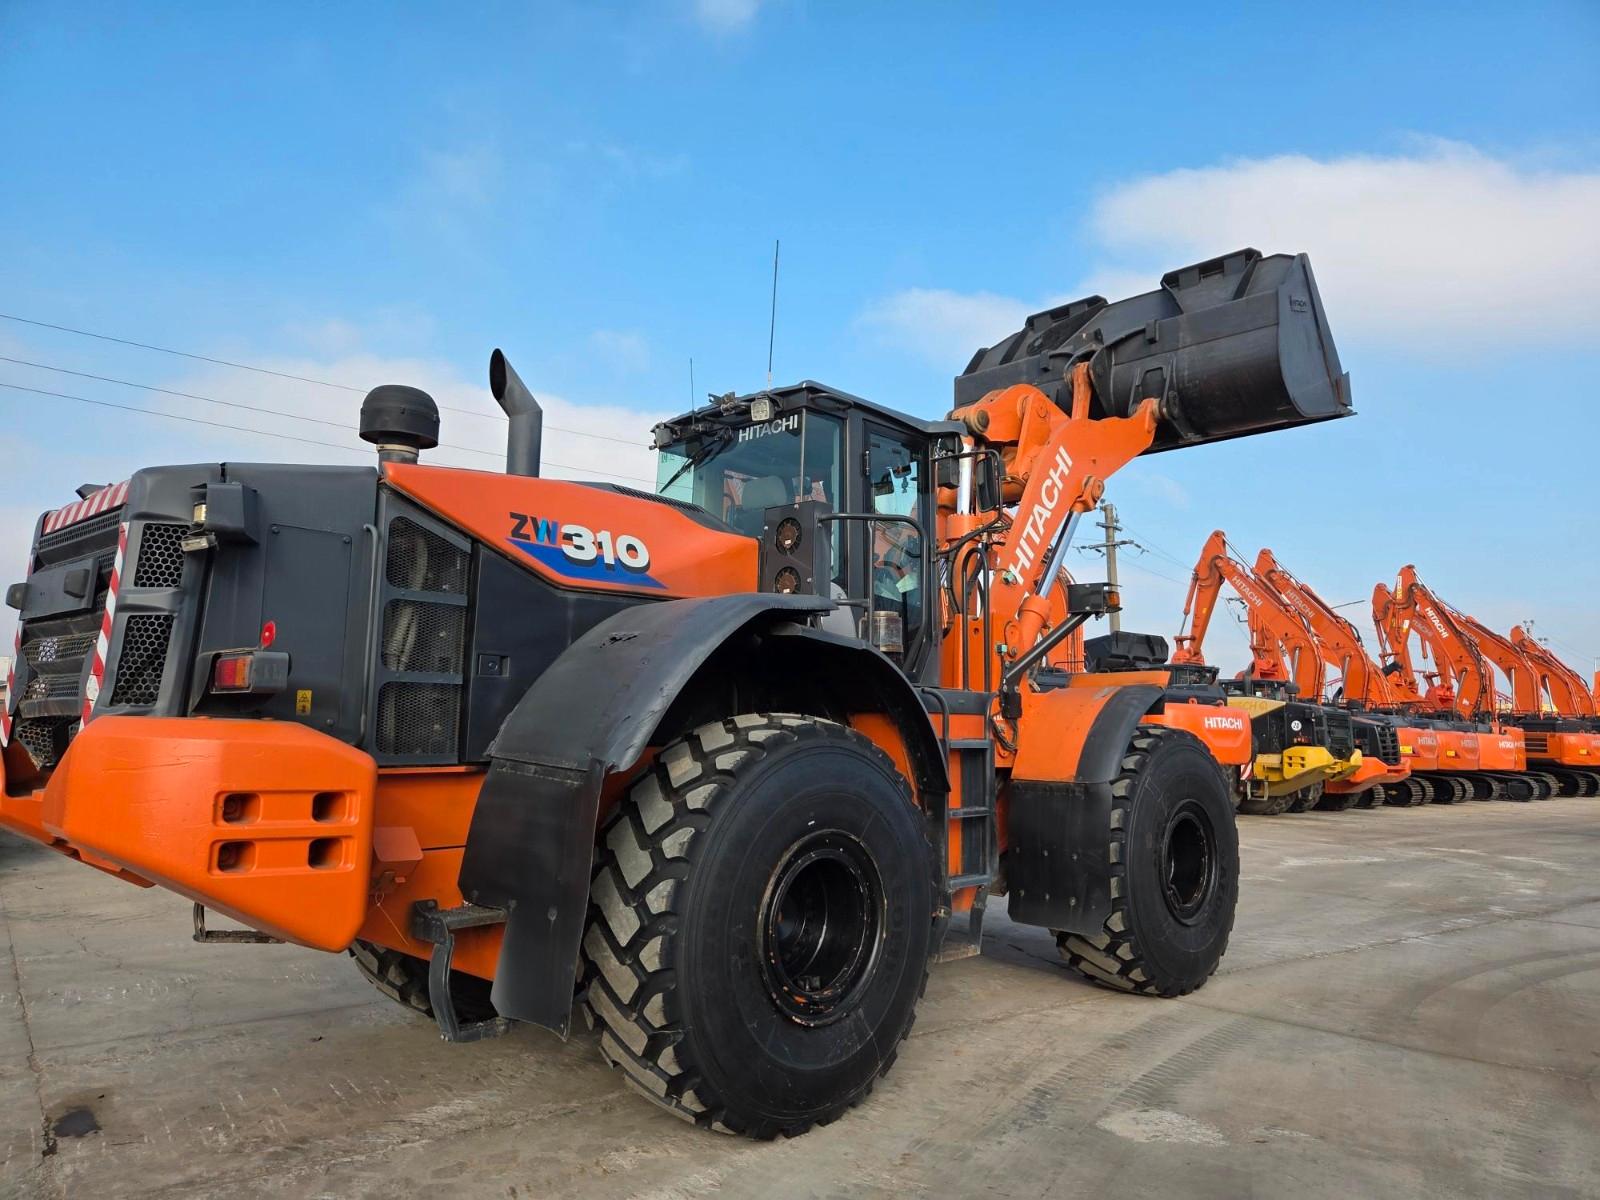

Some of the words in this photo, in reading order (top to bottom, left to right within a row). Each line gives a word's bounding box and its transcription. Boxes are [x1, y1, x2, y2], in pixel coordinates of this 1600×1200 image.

[739, 414, 798, 443] HITACHI
[1009, 446, 1073, 585] HITACHI
[1232, 576, 1263, 608] HITACHI
[1425, 607, 1449, 638] HITACHI
[1205, 717, 1243, 730] HITACHI
